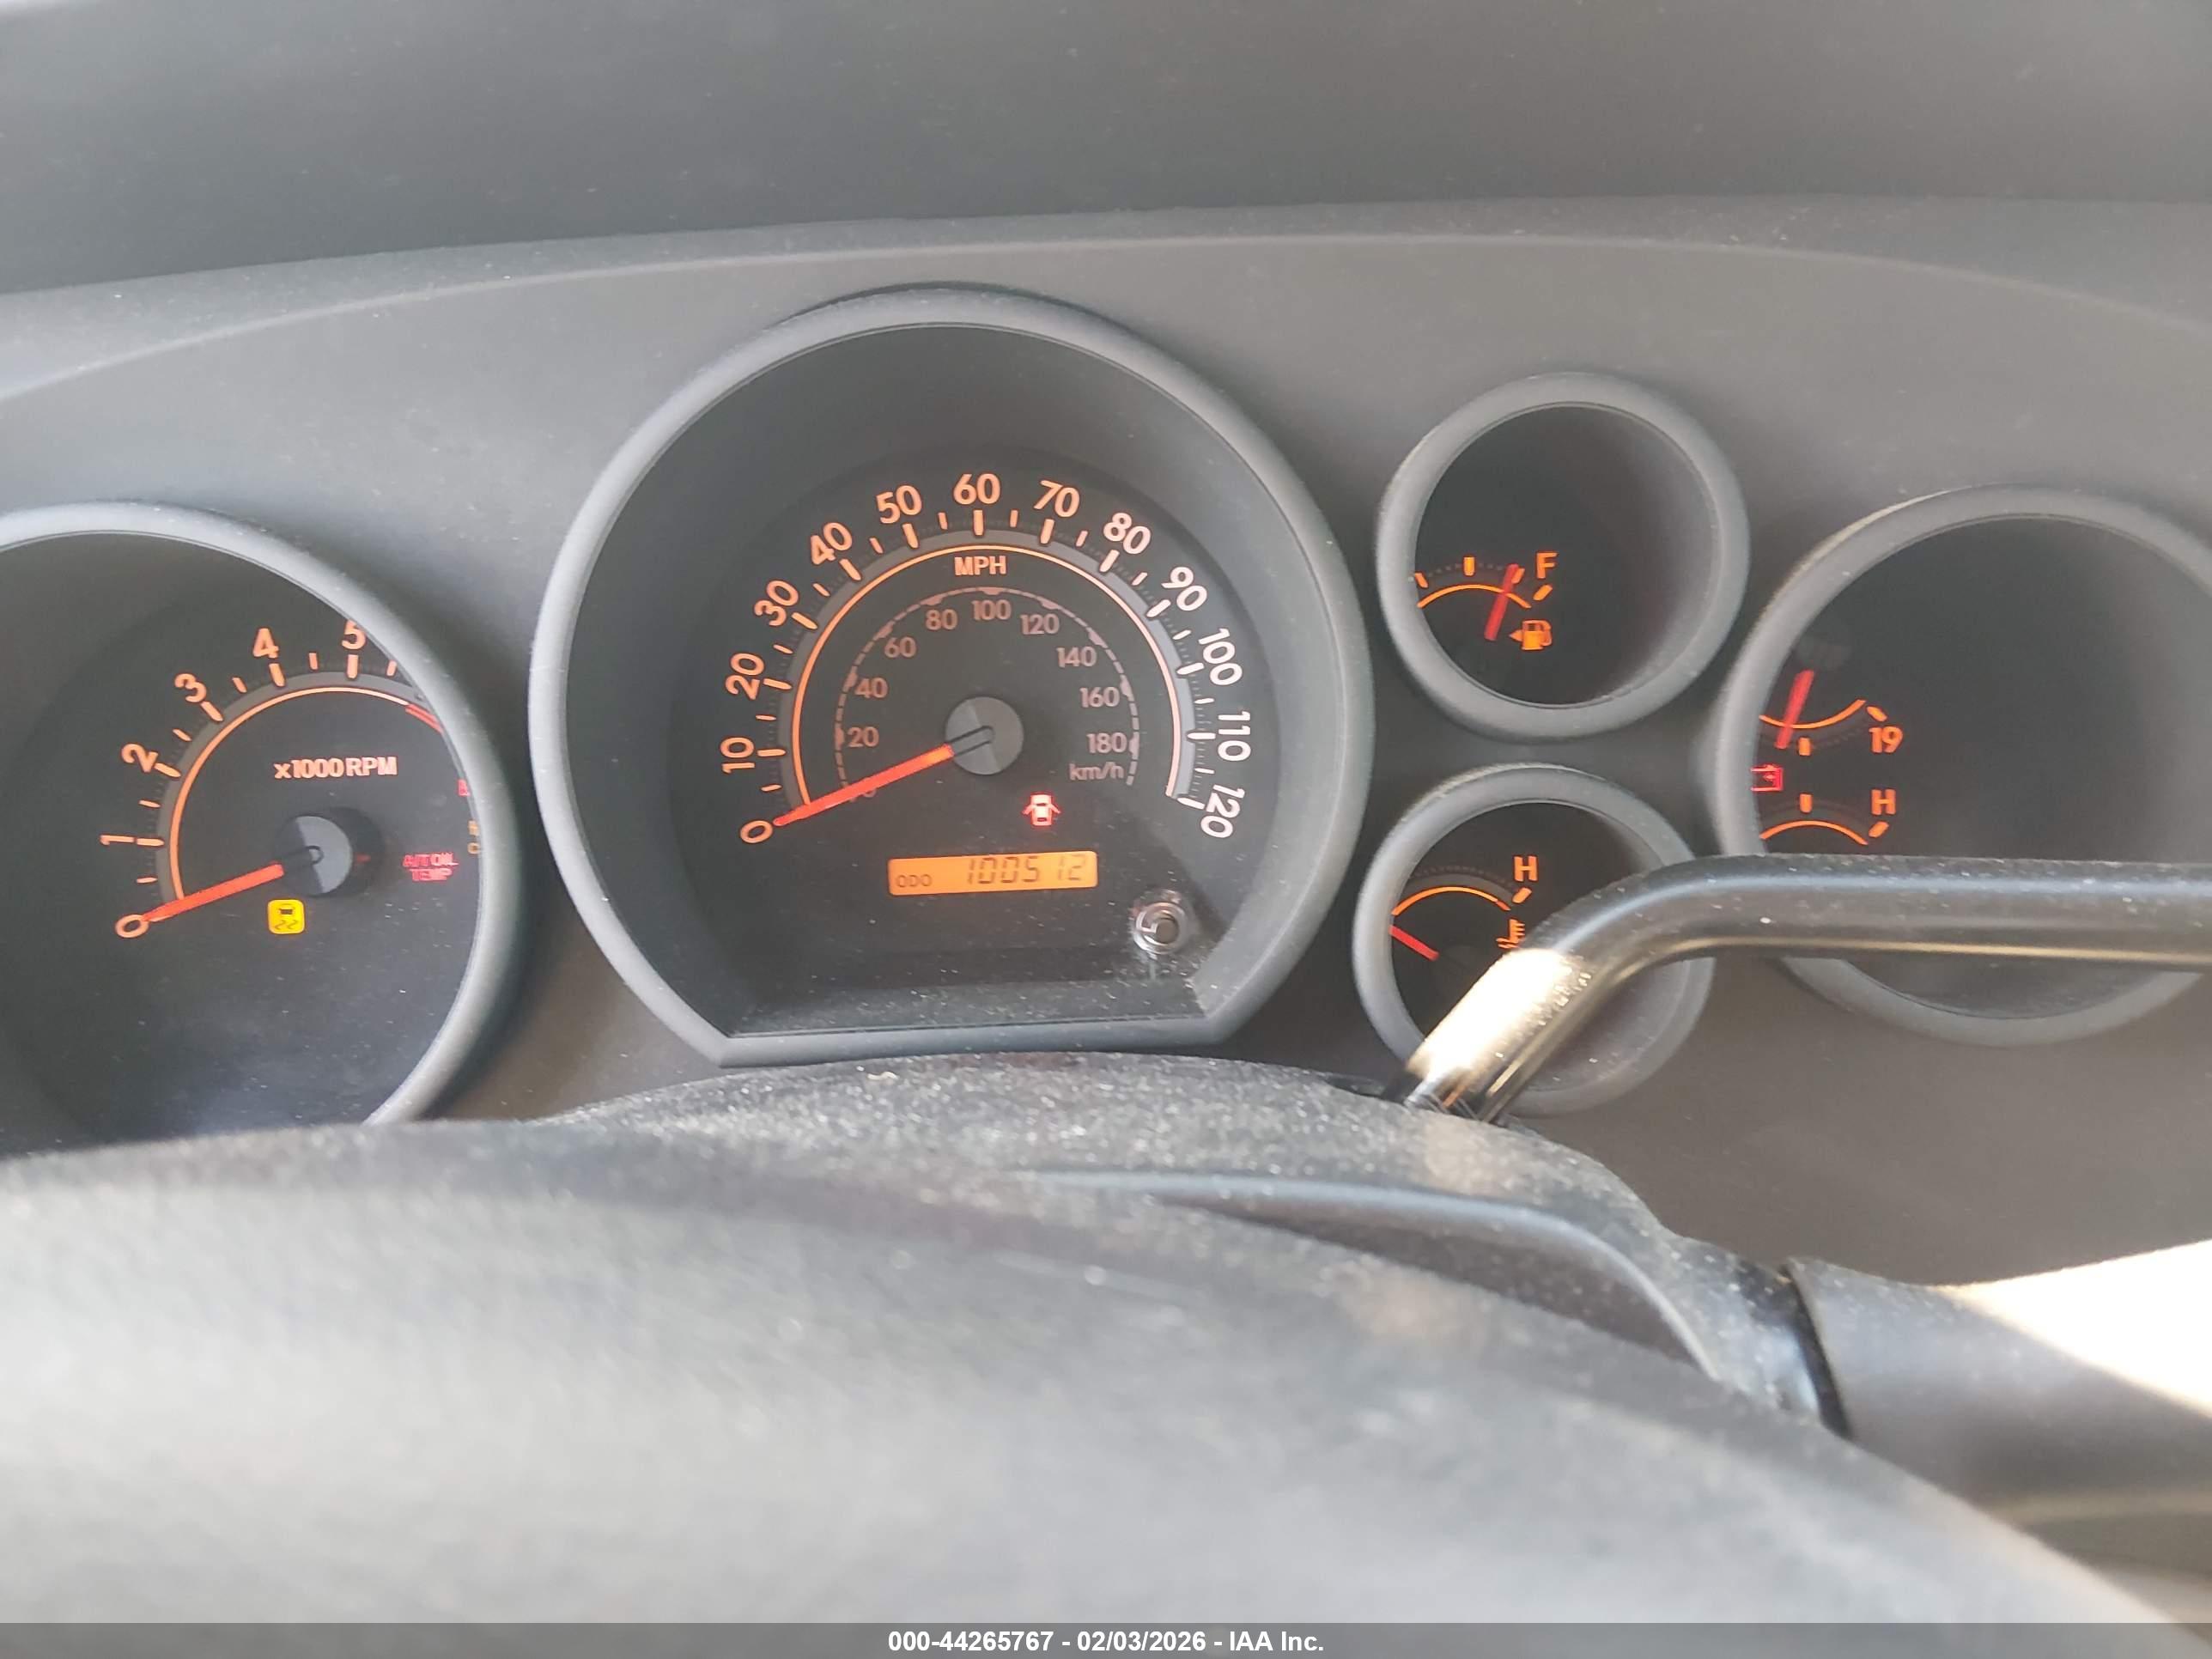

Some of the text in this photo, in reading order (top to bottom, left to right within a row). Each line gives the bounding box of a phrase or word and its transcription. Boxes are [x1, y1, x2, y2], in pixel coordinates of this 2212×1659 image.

[953, 474, 1000, 505] 60
[1033, 481, 1080, 518] 70
[876, 485, 923, 524] 50
[809, 522, 853, 565] 40
[1103, 513, 1152, 555] 80
[954, 556, 1006, 576] MPH
[1534, 552, 1558, 579] F
[1160, 567, 1207, 611] 90
[755, 580, 799, 627] 30
[971, 599, 1012, 621] 100
[925, 608, 958, 631] 80
[1020, 613, 1060, 635] 120
[252, 628, 279, 659] 4
[342, 620, 367, 650] 5
[884, 637, 917, 659] 60
[1057, 647, 1097, 668] 140
[1199, 628, 1243, 686] 100
[174, 672, 207, 703] 3
[726, 653, 764, 700] 20
[855, 679, 889, 700] 40
[1079, 687, 1120, 708] 160
[848, 727, 879, 749] 20
[1086, 732, 1127, 754] 180
[1218, 711, 1251, 763] 110
[1869, 726, 1903, 753] 19
[120, 744, 159, 773] 2
[274, 757, 398, 779] x1000 RPM
[721, 738, 754, 774] 10
[1069, 763, 1125, 782] km/h
[1200, 785, 1245, 839] 120
[1871, 789, 1896, 815] H
[739, 820, 773, 844] 0
[967, 854, 1086, 885] 100512
[1514, 855, 1538, 881] H
[115, 915, 149, 938] 0
